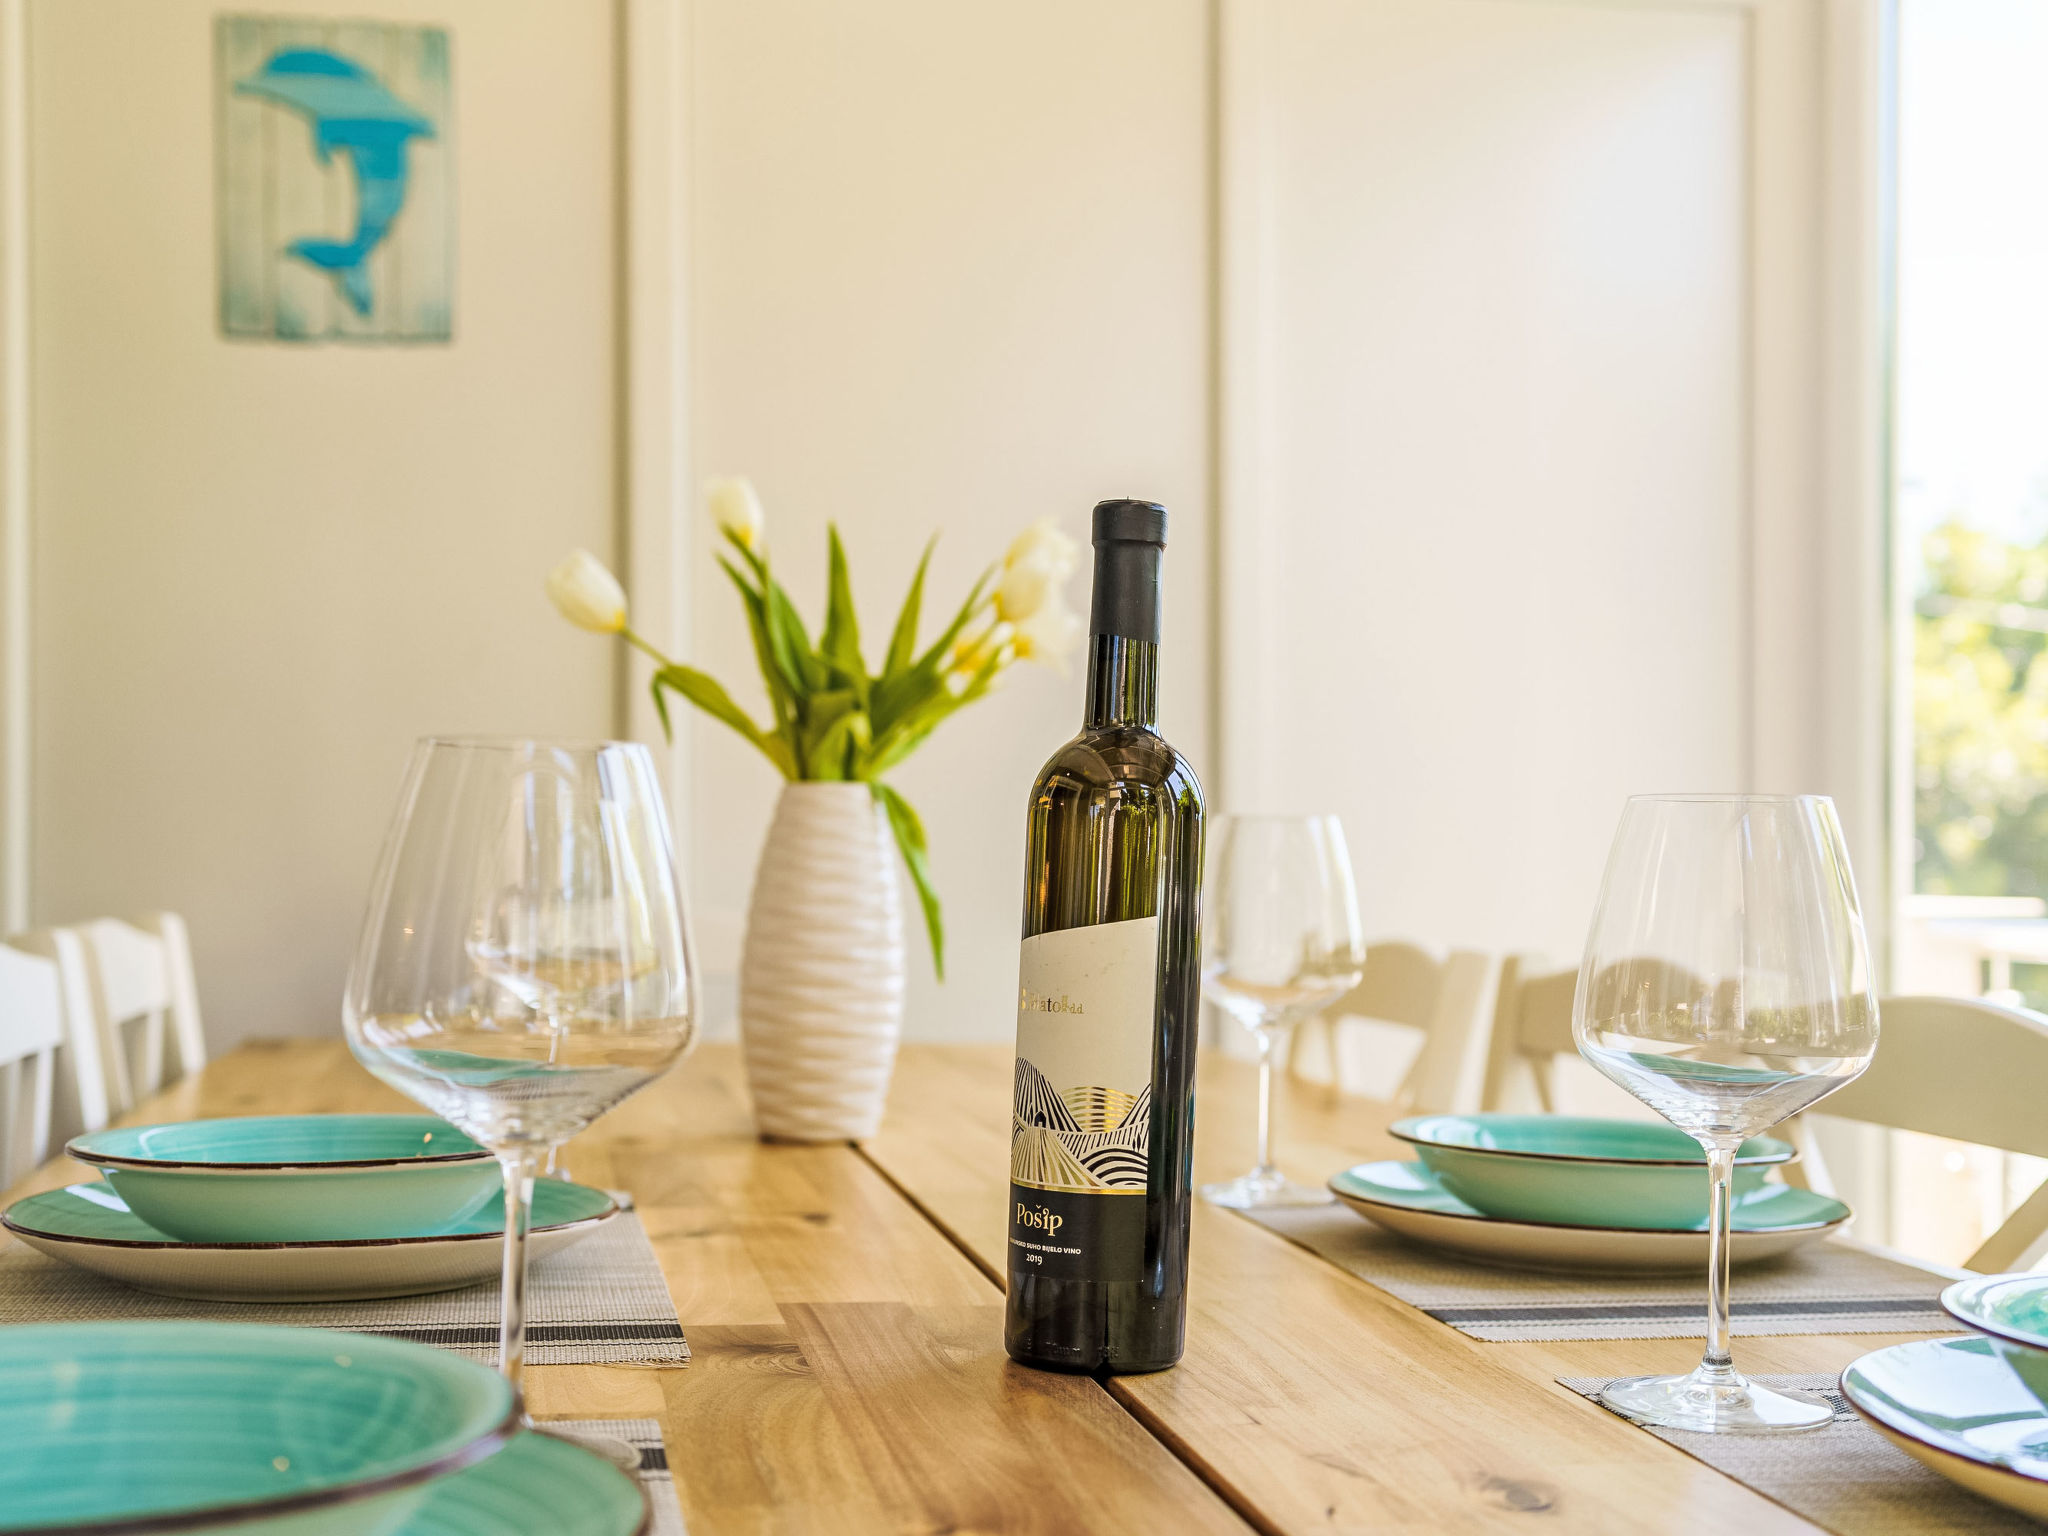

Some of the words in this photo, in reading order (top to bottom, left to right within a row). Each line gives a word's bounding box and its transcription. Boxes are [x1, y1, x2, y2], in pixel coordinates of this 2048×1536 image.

[1016, 1202, 1063, 1237] Pošip
[1063, 1247, 1082, 1255] VINO
[1026, 1253, 1043, 1266] 2019
